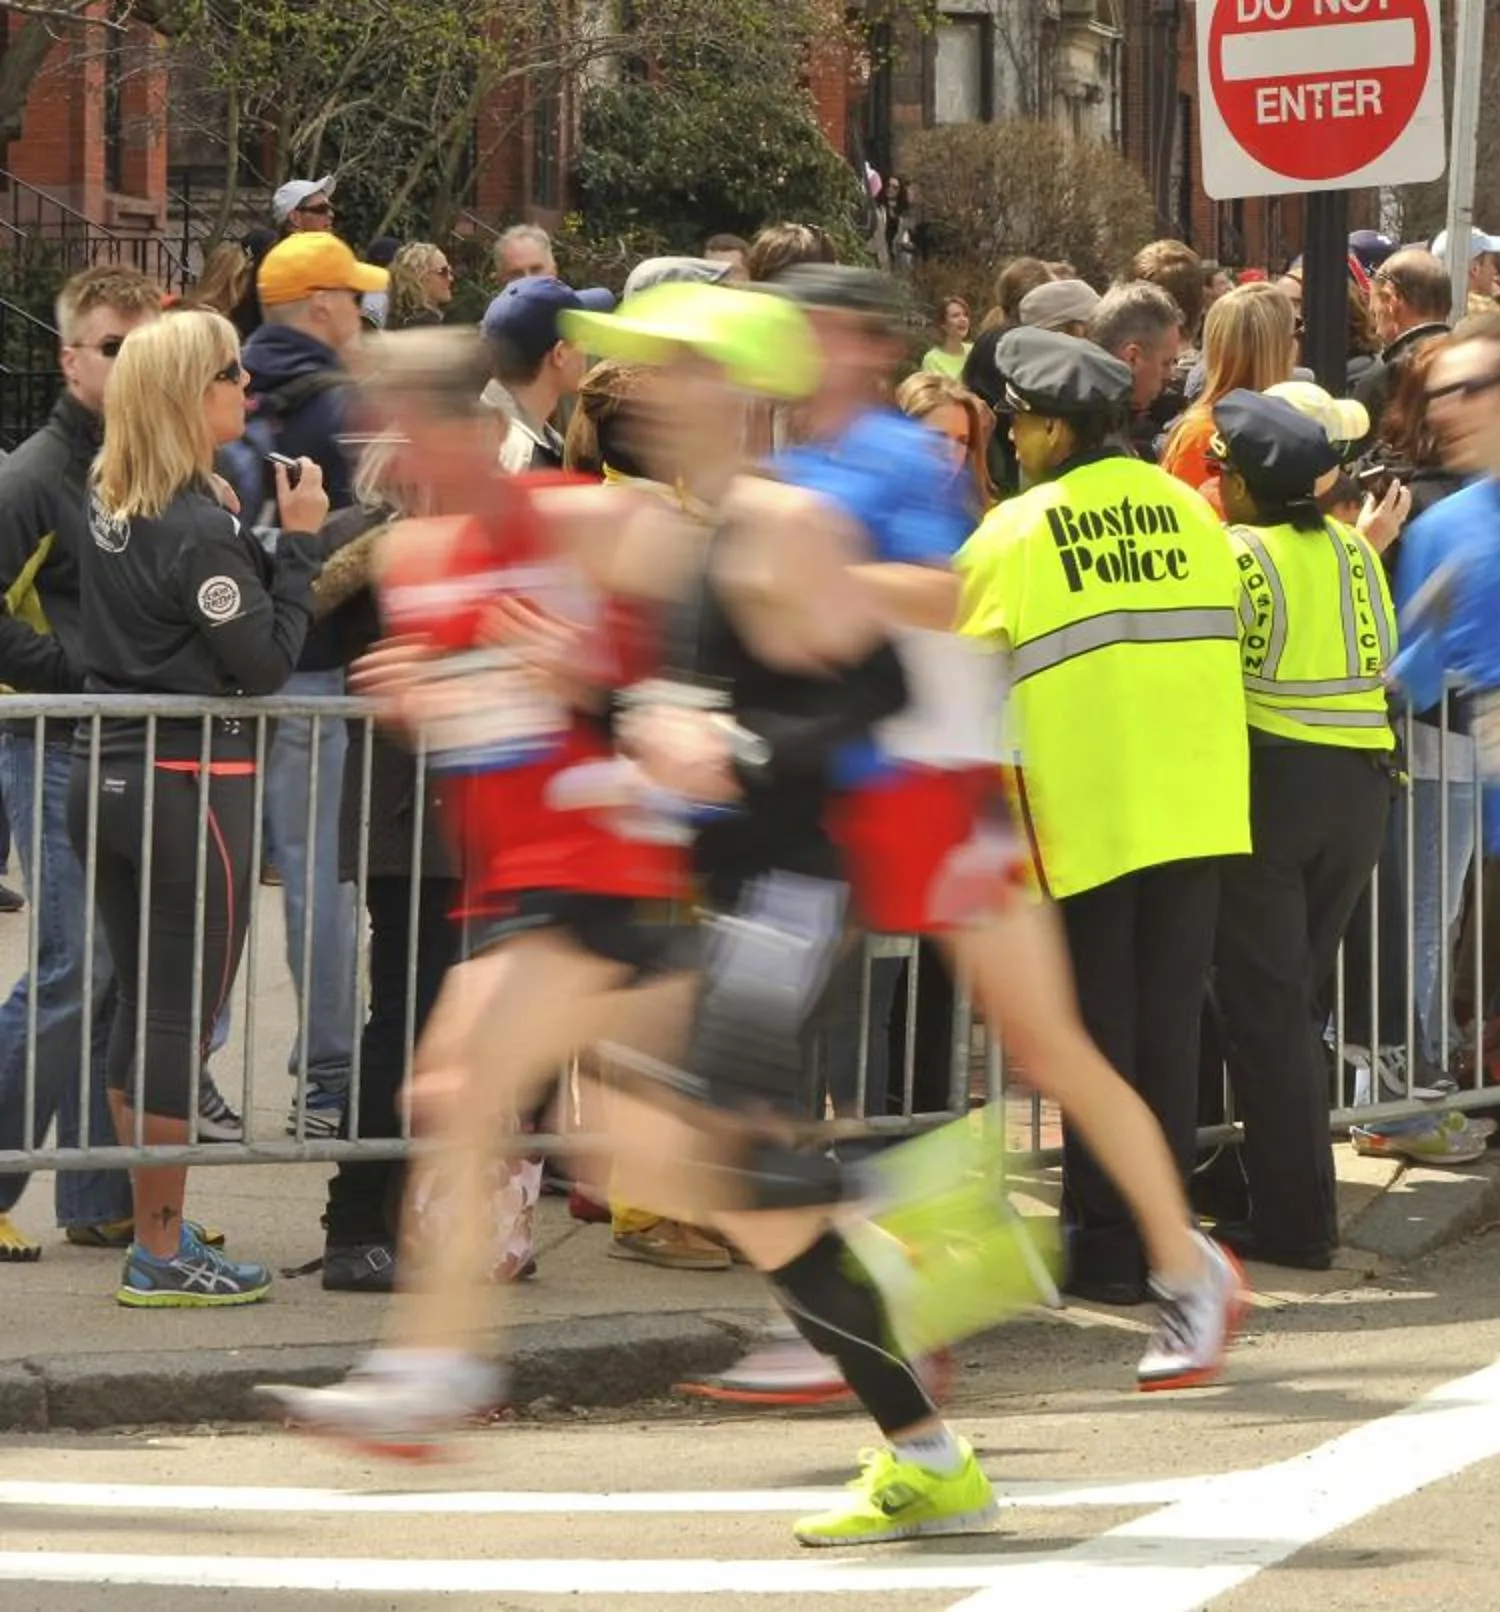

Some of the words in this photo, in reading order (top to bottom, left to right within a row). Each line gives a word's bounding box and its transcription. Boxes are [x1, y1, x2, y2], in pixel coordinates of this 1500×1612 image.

[1256, 79, 1383, 124] ENTER
[1045, 496, 1180, 547] Boston
[1059, 538, 1189, 592] Police
[1237, 553, 1271, 669] BOSTON
[1346, 543, 1378, 671] POLICE
